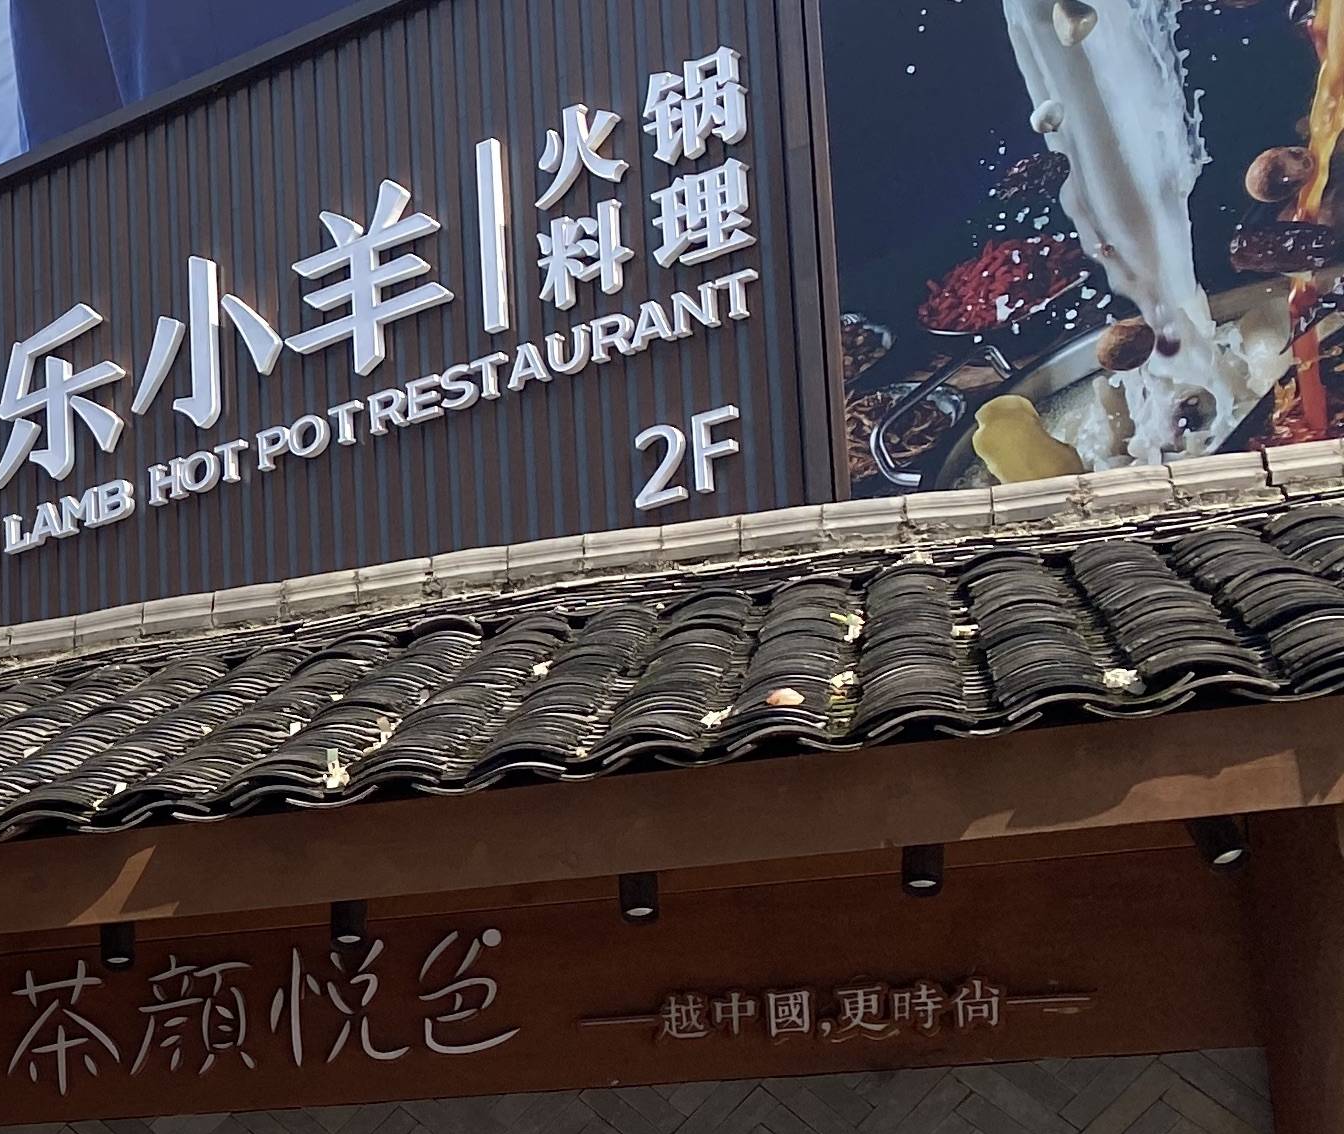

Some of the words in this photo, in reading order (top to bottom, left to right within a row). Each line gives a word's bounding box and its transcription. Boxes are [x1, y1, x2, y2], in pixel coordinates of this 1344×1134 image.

[535, 45, 748, 210] 火锅
[536, 157, 757, 310] 料理
[3, 479, 136, 556] LAMB
[147, 438, 249, 507] HOT
[256, 399, 364, 472] POT
[367, 268, 759, 437] RESTAURANT
[634, 404, 740, 512] 2F
